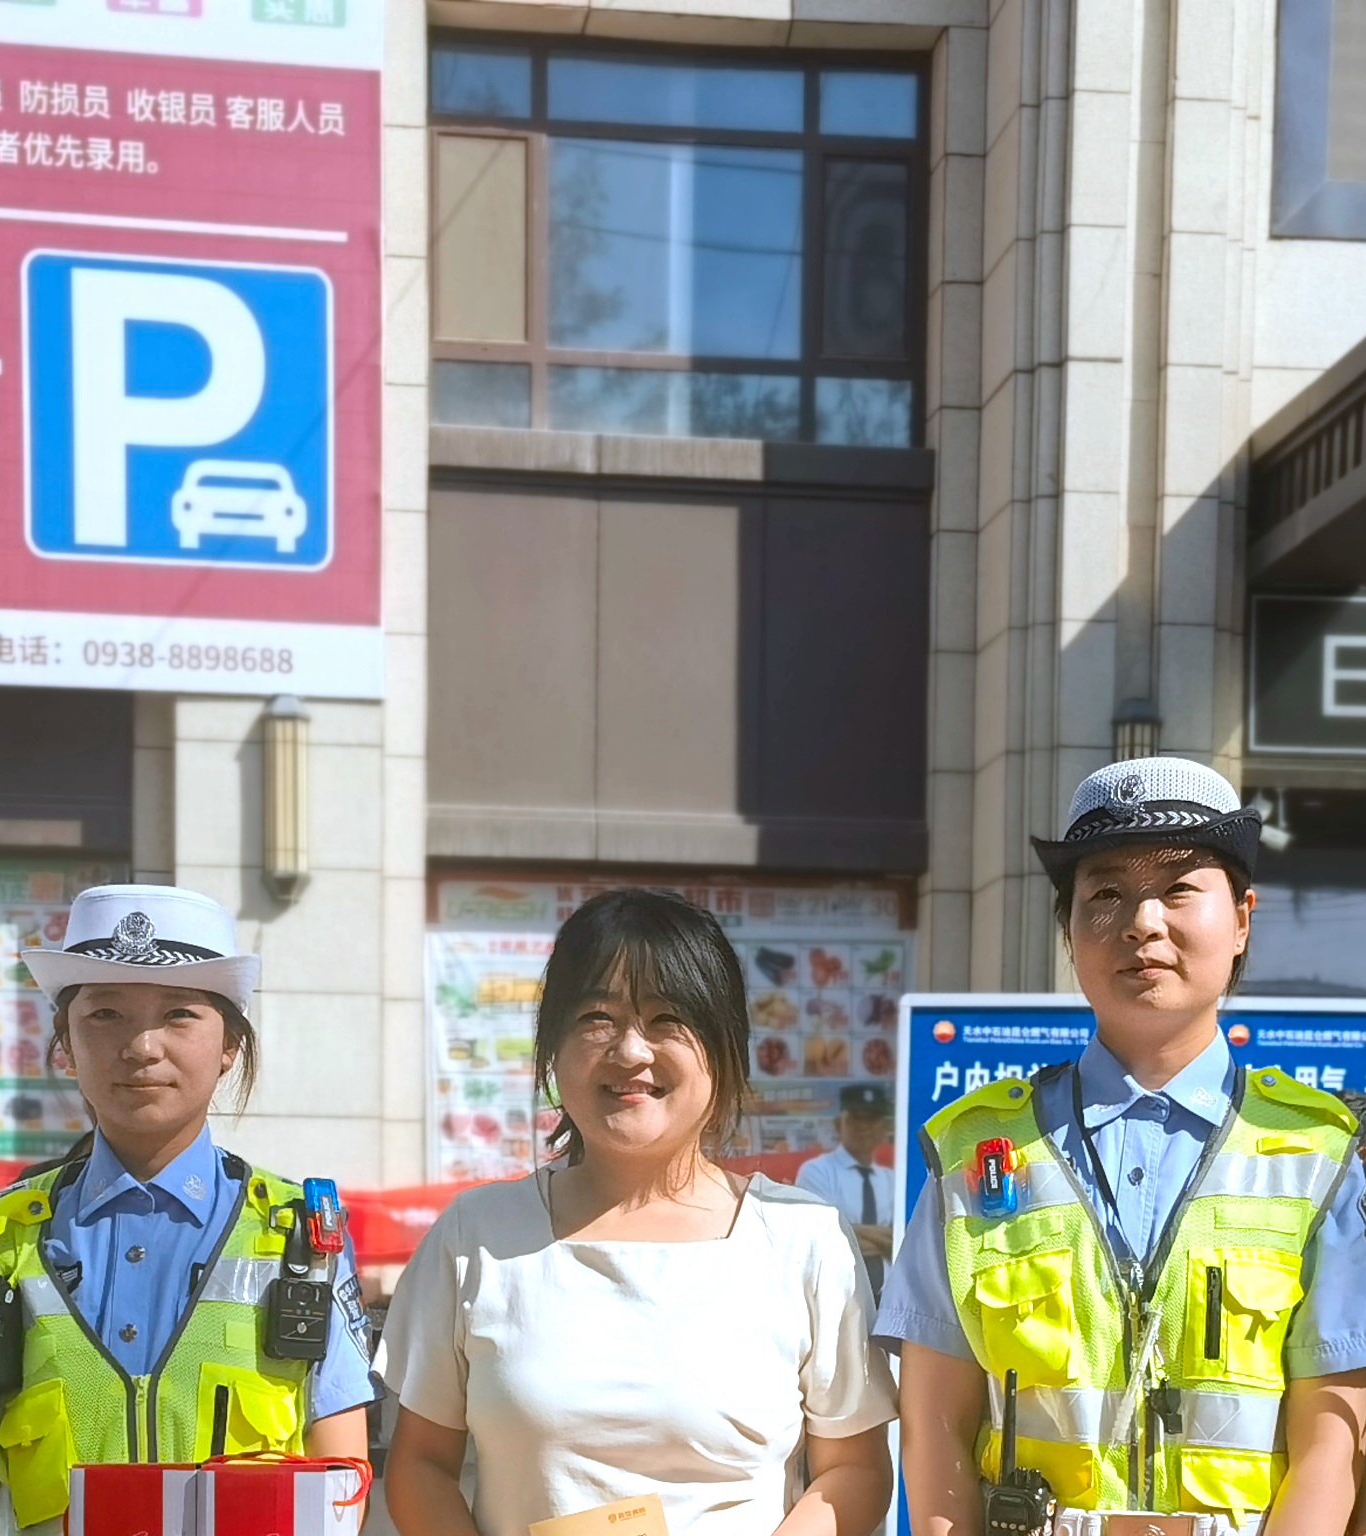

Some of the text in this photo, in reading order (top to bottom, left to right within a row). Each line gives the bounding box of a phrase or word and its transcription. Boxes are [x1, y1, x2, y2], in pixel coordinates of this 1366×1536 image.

[20, 81, 110, 120] 防损员
[127, 89, 217, 128] 收银员
[226, 97, 346, 136] 客服人员
[71, 267, 266, 545] P
[988, 1159, 999, 1189] POLICE
